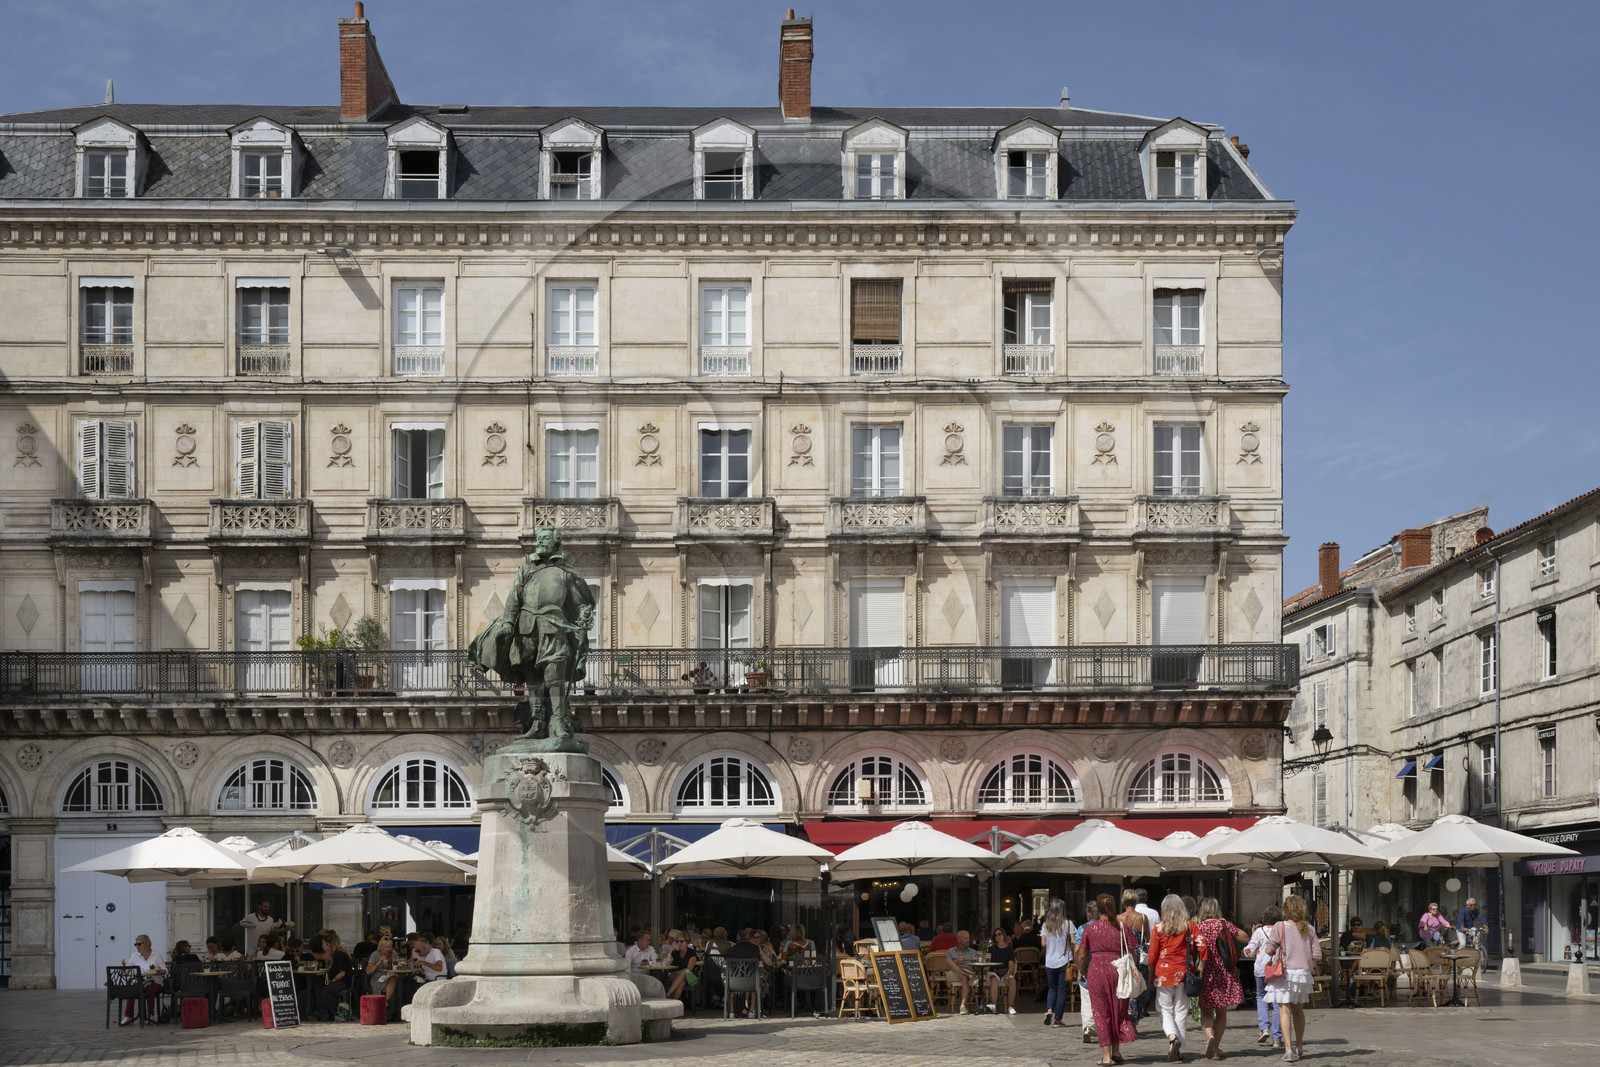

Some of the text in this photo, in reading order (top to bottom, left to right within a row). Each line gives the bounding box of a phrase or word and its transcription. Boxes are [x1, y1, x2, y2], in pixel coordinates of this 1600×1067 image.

[1540, 833, 1579, 844] OPTIQUE DUPATY
[1529, 858, 1586, 875] OPTIQUE DUPATY
